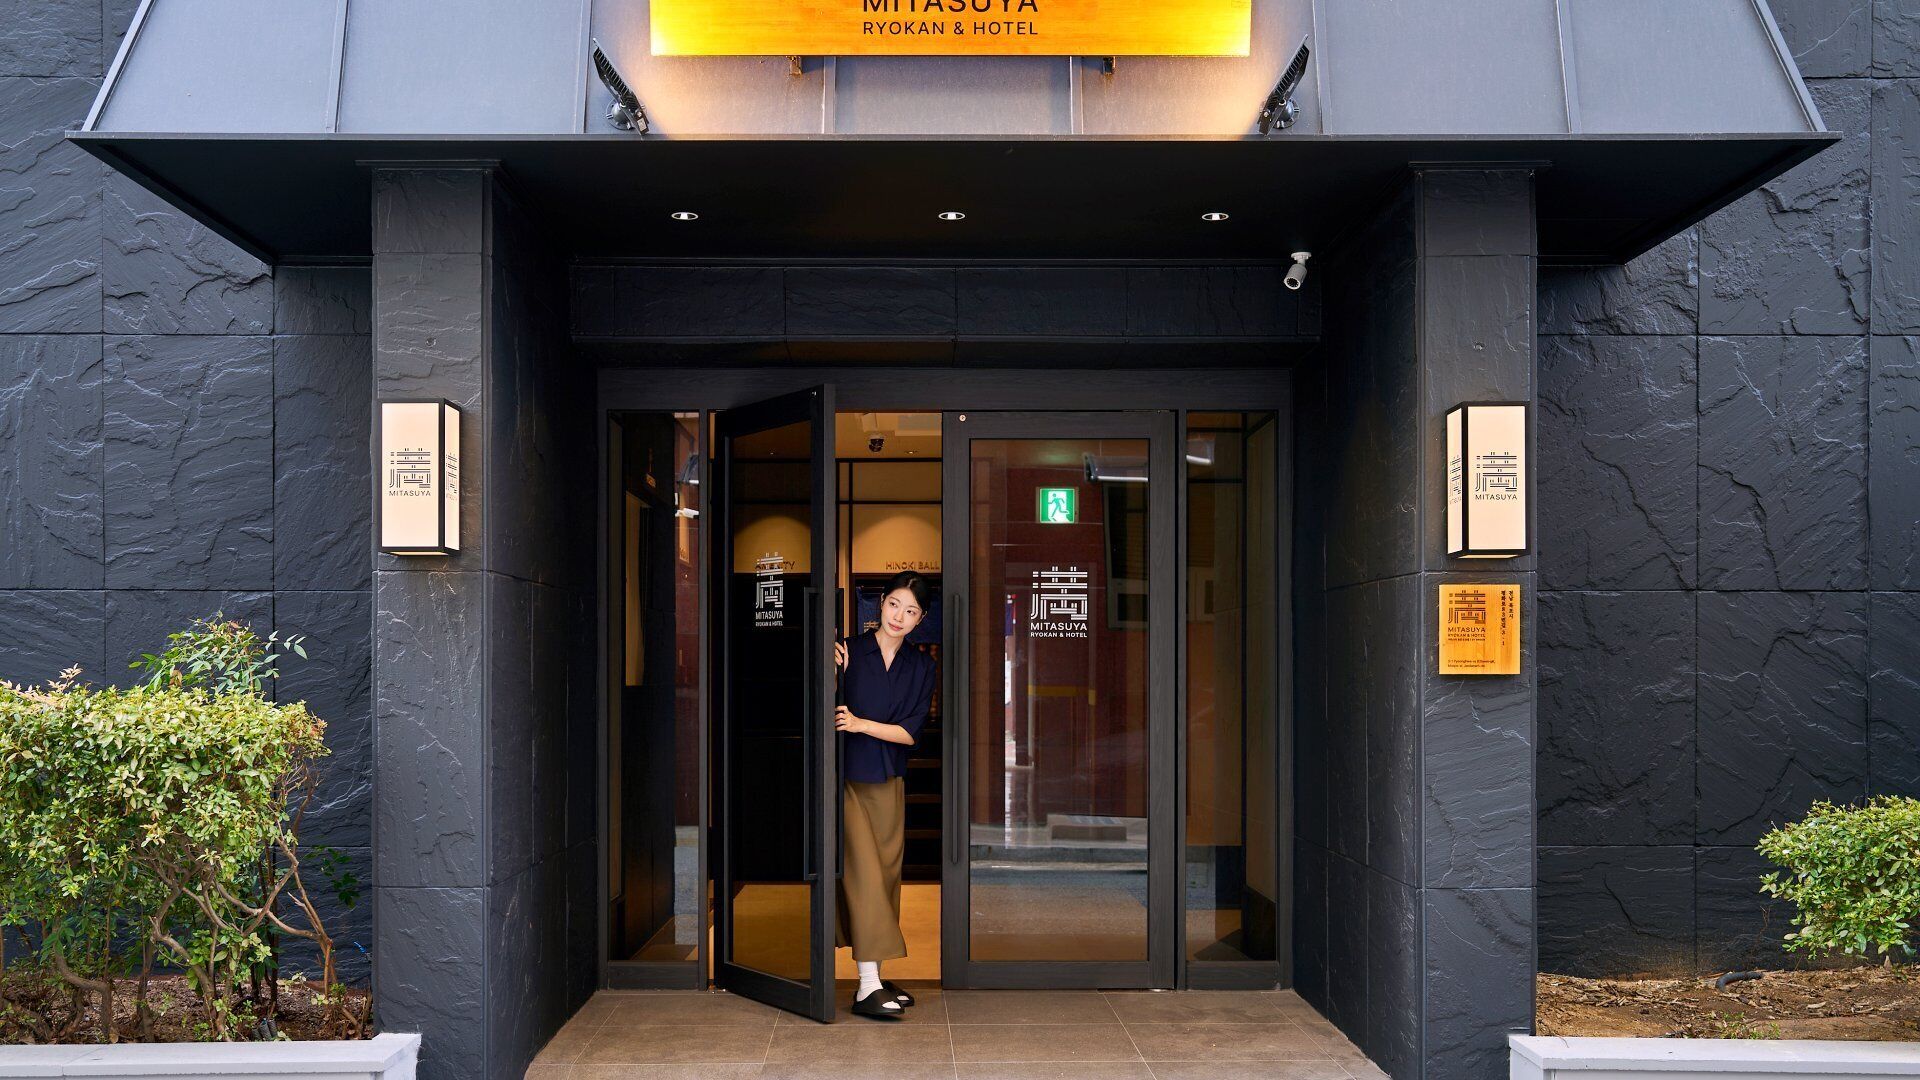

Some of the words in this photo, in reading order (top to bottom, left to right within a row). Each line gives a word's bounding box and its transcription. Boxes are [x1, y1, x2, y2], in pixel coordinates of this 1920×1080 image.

[863, 21, 945, 35] RYOKAN
[953, 21, 965, 35] &
[973, 21, 1038, 35] HOTEL
[1475, 493, 1518, 501] MITASUYA
[886, 561, 916, 570] HINOKI
[918, 561, 940, 570] BALL
[755, 610, 784, 620] MITASUYA
[1030, 622, 1088, 631] MITASUYA
